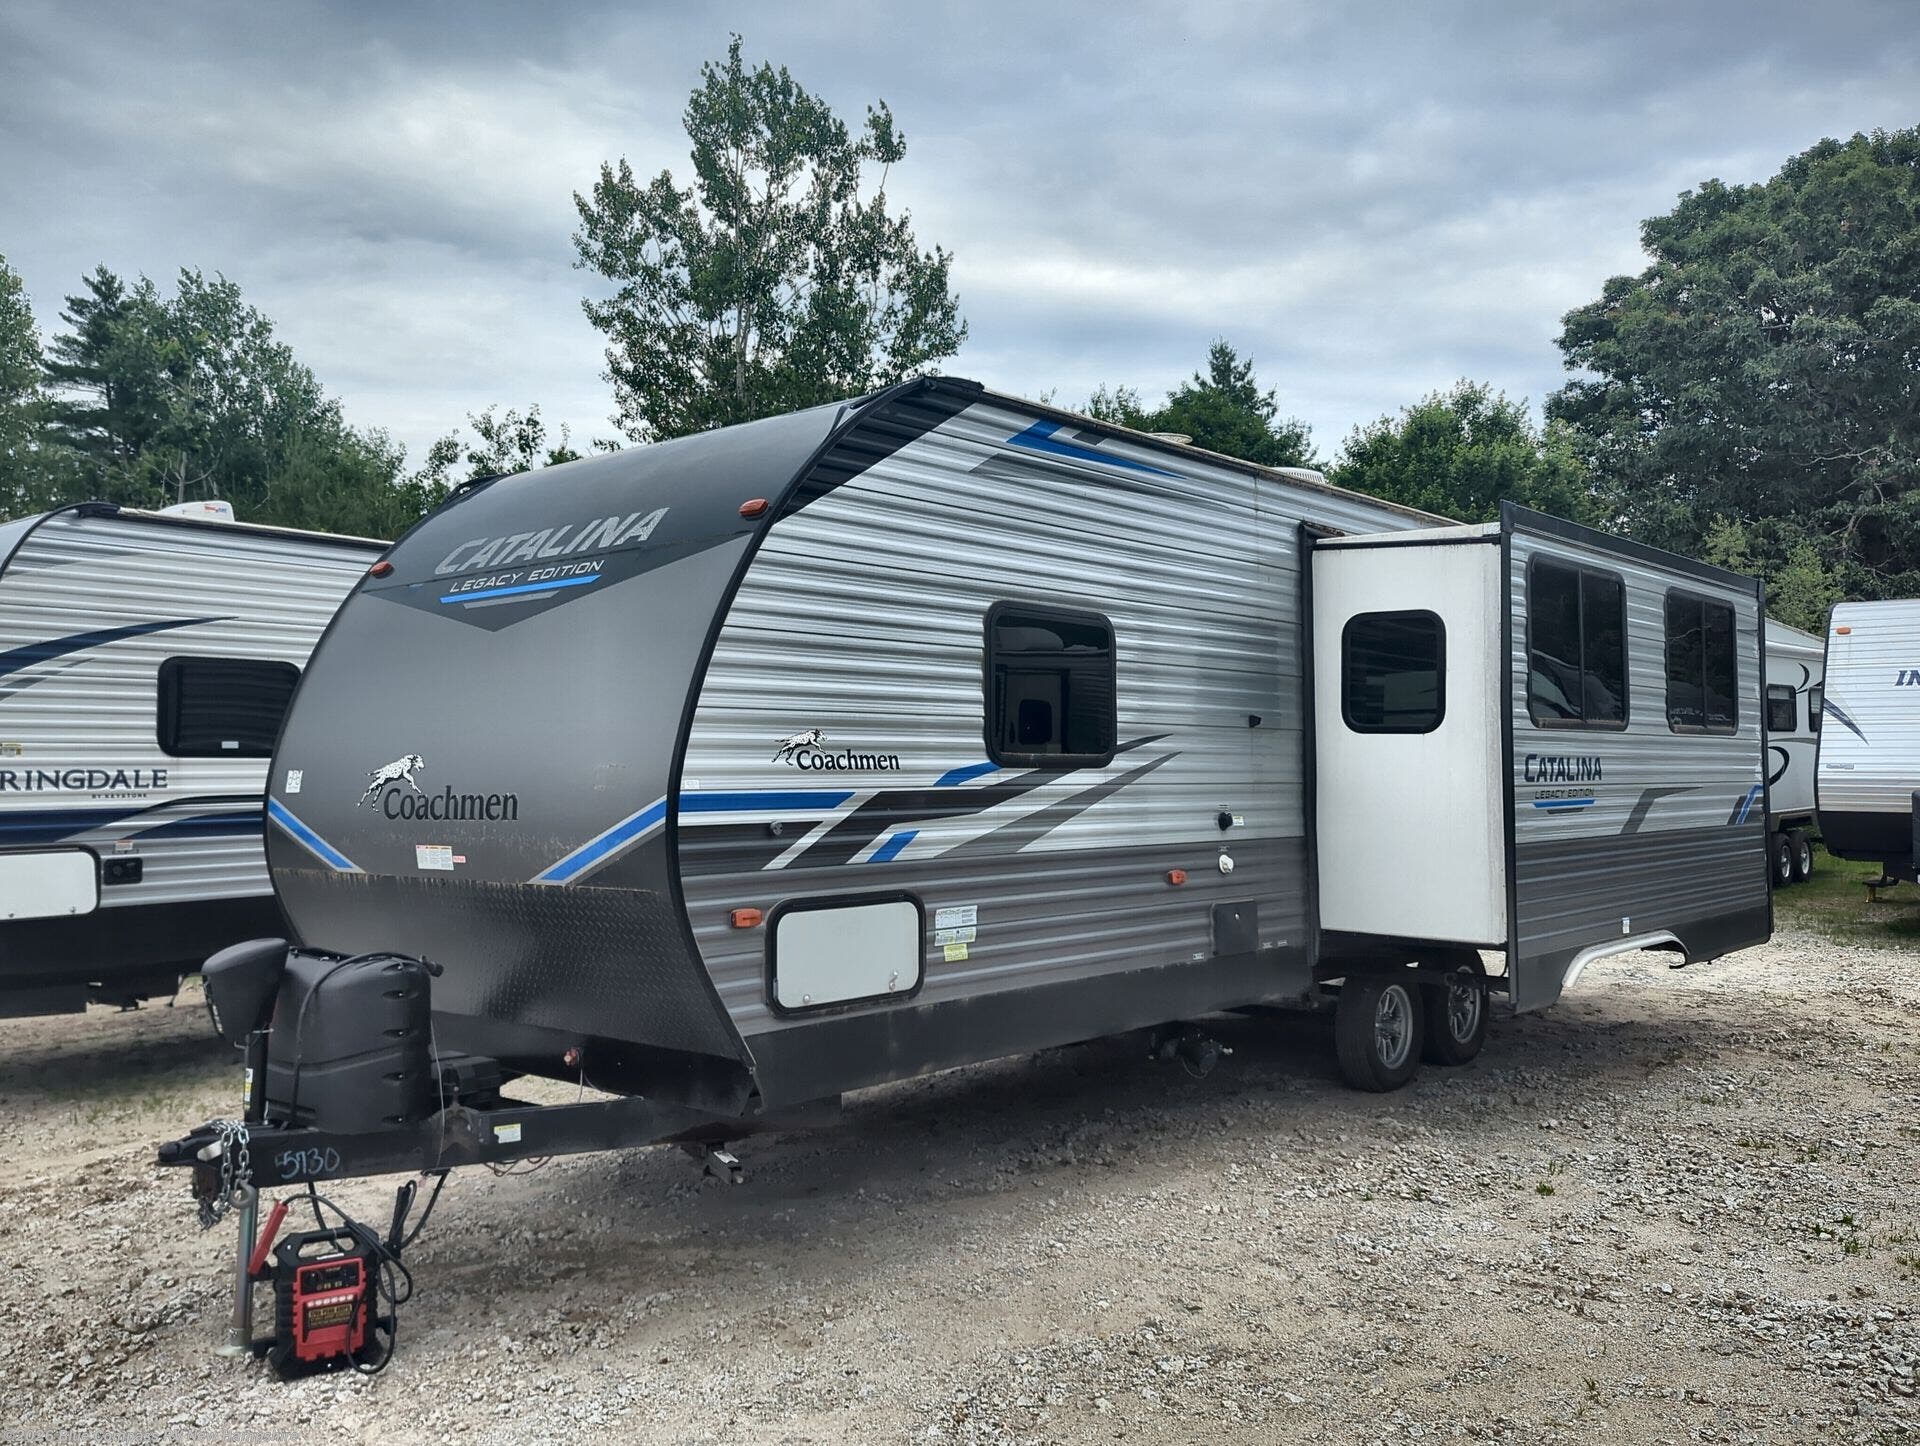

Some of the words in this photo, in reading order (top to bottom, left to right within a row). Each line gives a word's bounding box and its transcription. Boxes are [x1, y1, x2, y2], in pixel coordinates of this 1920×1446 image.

[434, 507, 671, 575] CATALINA
[450, 572, 524, 592] LEGACY
[528, 560, 605, 581] EDITION
[796, 749, 900, 770] Coachmen
[1524, 754, 1602, 782] CATALINA
[0, 769, 168, 791] RINGDALE
[1535, 790, 1565, 799] LEGACY
[1568, 788, 1594, 797] EDITION
[383, 785, 519, 821] Coachmen
